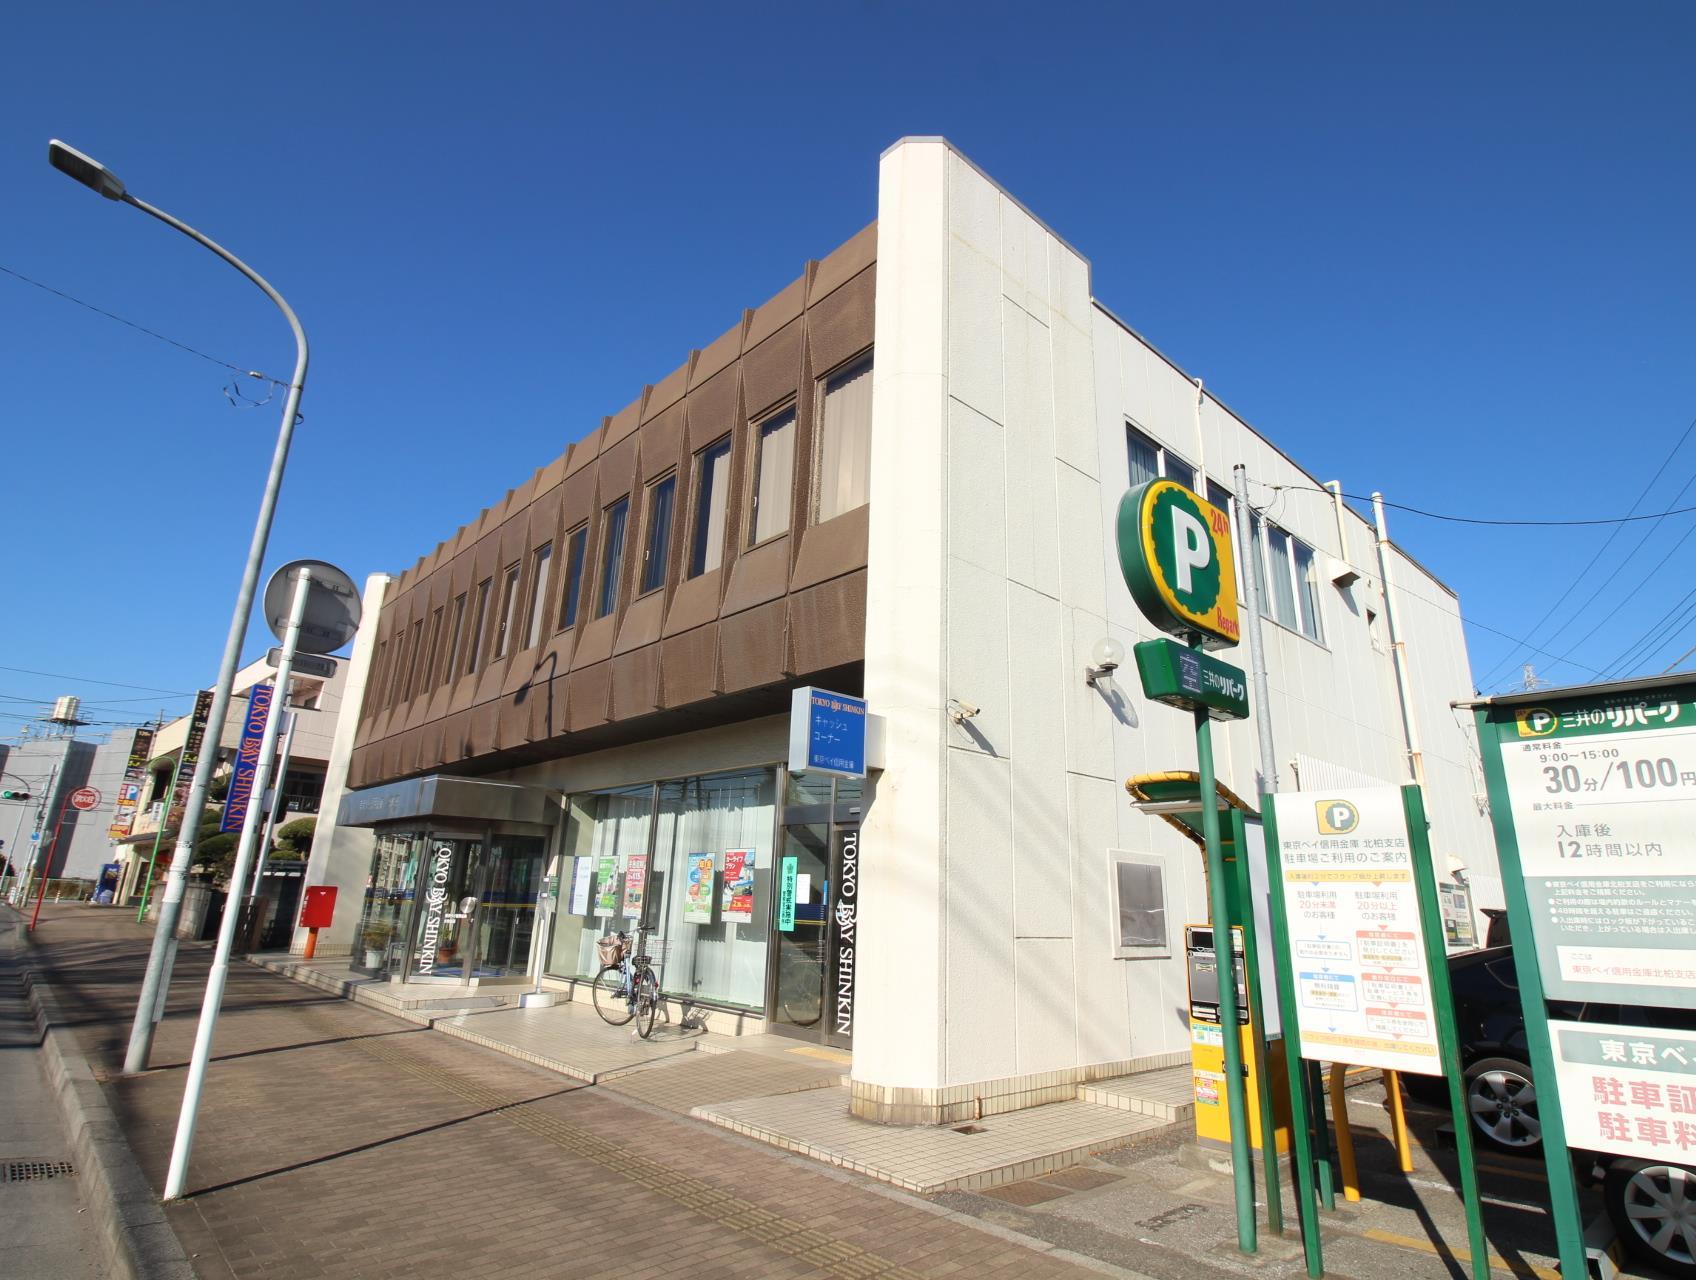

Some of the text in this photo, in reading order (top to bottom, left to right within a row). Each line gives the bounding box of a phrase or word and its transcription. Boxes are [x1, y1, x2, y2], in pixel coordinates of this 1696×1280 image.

[1171, 504, 1211, 595] P
[1203, 669, 1244, 701] 三井のリパーク
[248, 687, 273, 734] TOKYO
[812, 696, 831, 708] TOKYO
[843, 702, 864, 715] SHINKIN
[1560, 700, 1680, 729] 三井のリパーク
[815, 714, 848, 732] キャッシュ
[1532, 711, 1551, 731] P
[814, 731, 841, 744] コーナー
[1522, 741, 1562, 752] 通常料金
[126, 785, 138, 799] P
[226, 767, 255, 831] SHINKIN
[1533, 801, 1575, 812] 最大料金
[1332, 807, 1350, 828] P
[1556, 823, 1612, 839] 入庫後
[1283, 838, 1405, 850] 東京ベイ信用金庫 北柏支店
[1557, 840, 1663, 859] 12時間以内
[841, 832, 857, 897] TOKYO
[1284, 852, 1408, 864] 駐車場ご利用のご案内
[1357, 901, 1398, 911] 20分以上
[419, 916, 440, 975] SHINKIN
[837, 946, 853, 1036] SHINKIN
[1598, 1039, 1696, 1066] 東京ベ
